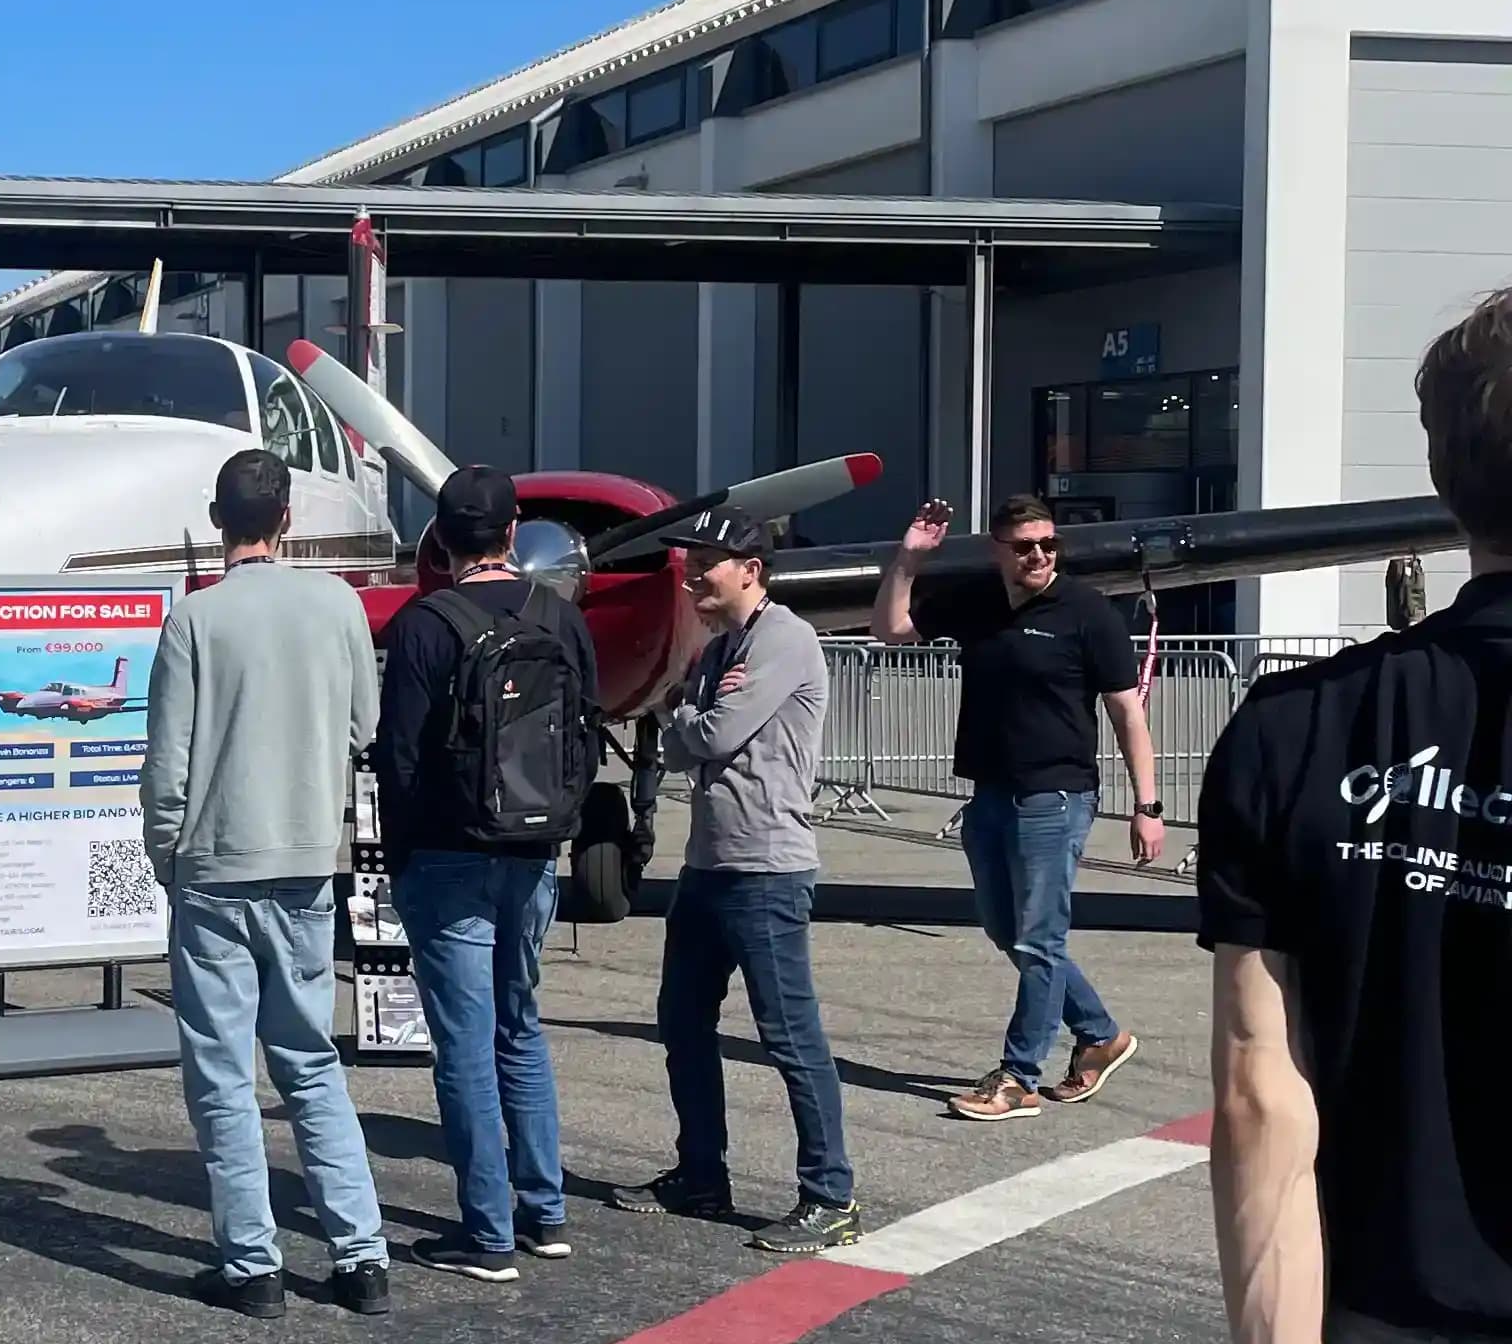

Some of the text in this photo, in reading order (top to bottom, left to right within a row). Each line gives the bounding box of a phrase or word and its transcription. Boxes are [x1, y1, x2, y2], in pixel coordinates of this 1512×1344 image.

[1102, 330, 1128, 358] A5
[60, 605, 95, 619] FOR
[99, 604, 151, 619] SALE!
[16, 645, 41, 654] From
[82, 744, 102, 753] Total
[6, 811, 17, 822] A
[19, 810, 70, 822] HIGHER
[73, 808, 96, 820] BID
[98, 807, 127, 818] AND
[1336, 842, 1383, 860] THE
[1405, 871, 1446, 892] OF
